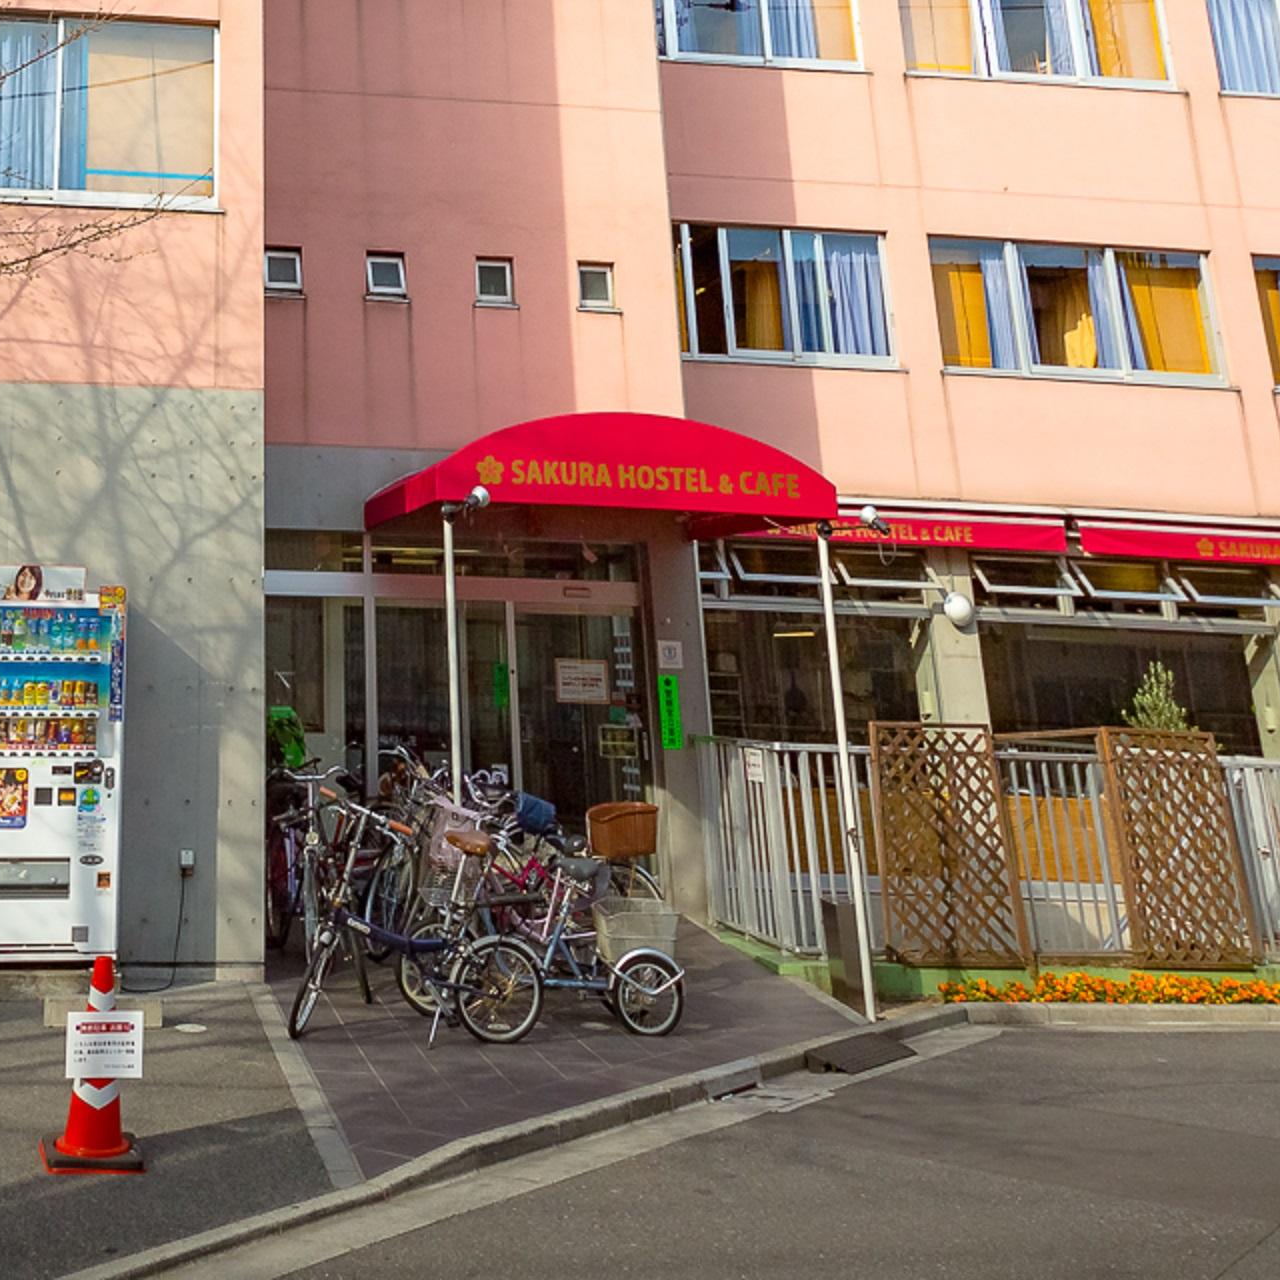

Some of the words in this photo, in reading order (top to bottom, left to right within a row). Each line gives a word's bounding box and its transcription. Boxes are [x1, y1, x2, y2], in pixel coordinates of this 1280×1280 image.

[511, 459, 612, 488] SAKURA
[618, 464, 713, 494] HOSTEL
[718, 474, 734, 495] &
[739, 471, 801, 499] CAFE
[921, 528, 931, 542] &
[934, 526, 974, 543] CAFE
